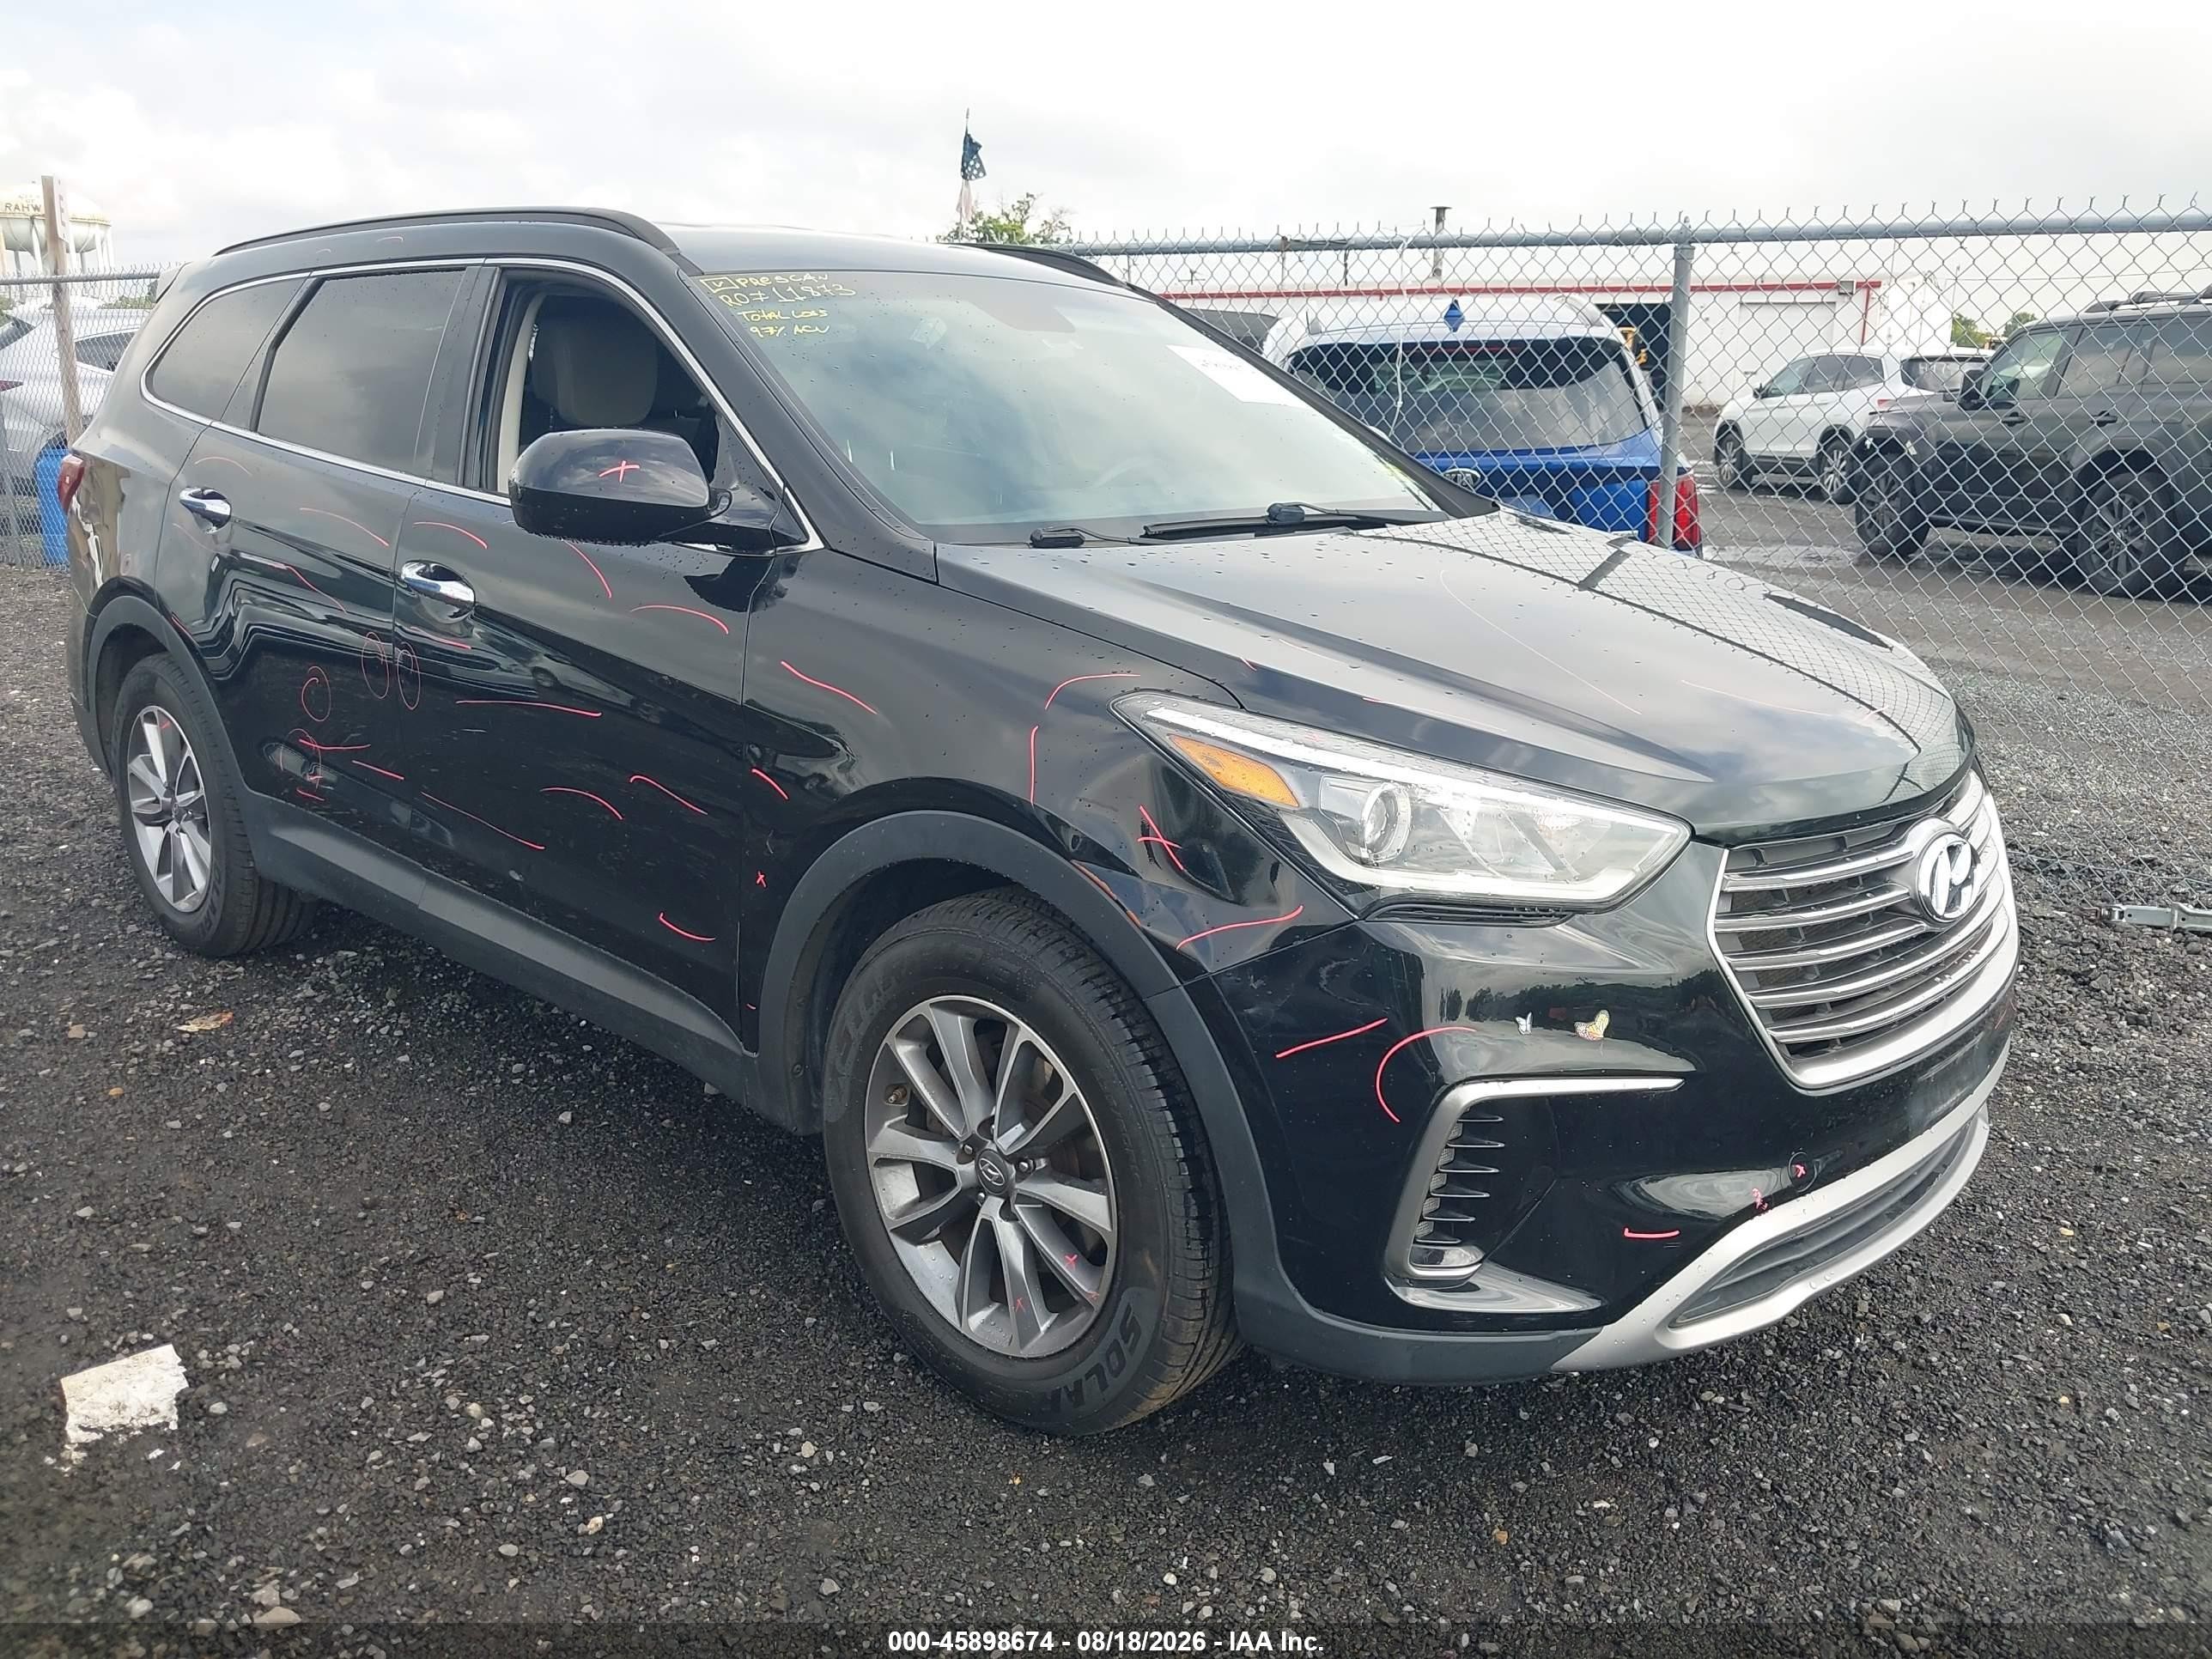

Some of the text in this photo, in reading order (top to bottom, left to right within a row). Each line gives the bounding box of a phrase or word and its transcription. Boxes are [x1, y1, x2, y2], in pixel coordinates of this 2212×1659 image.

[4, 202, 42, 213] RAHW
[775, 273, 829, 283] SCAN
[772, 283, 856, 302] 11873
